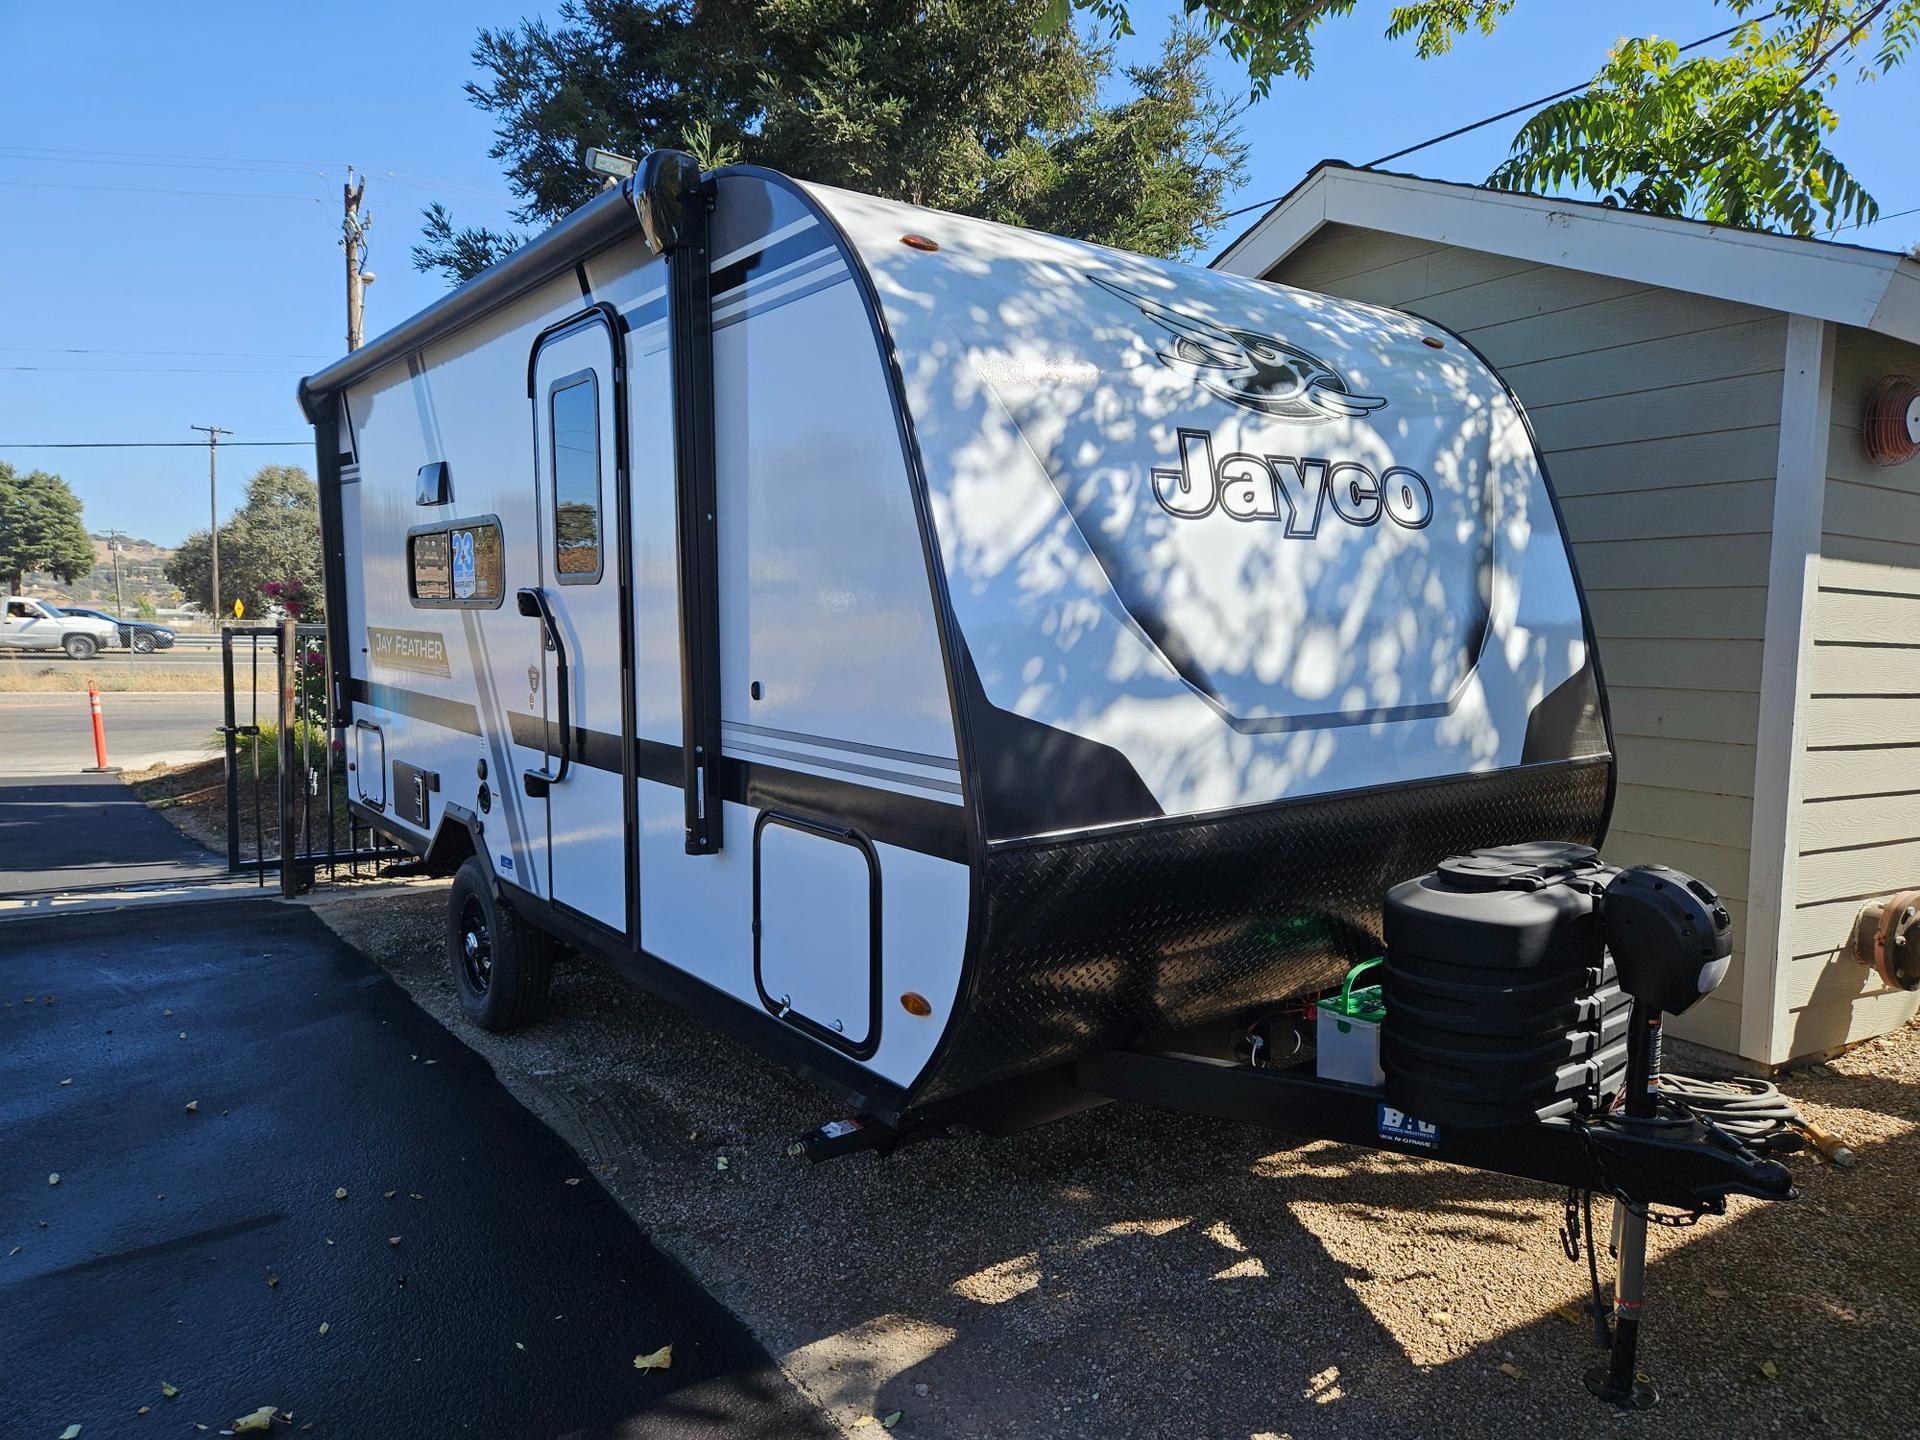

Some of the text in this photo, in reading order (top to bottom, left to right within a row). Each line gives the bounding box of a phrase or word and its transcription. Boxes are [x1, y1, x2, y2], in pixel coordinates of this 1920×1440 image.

[1151, 427, 1433, 540] Jayco
[376, 633, 442, 660] JAY FEATHER
